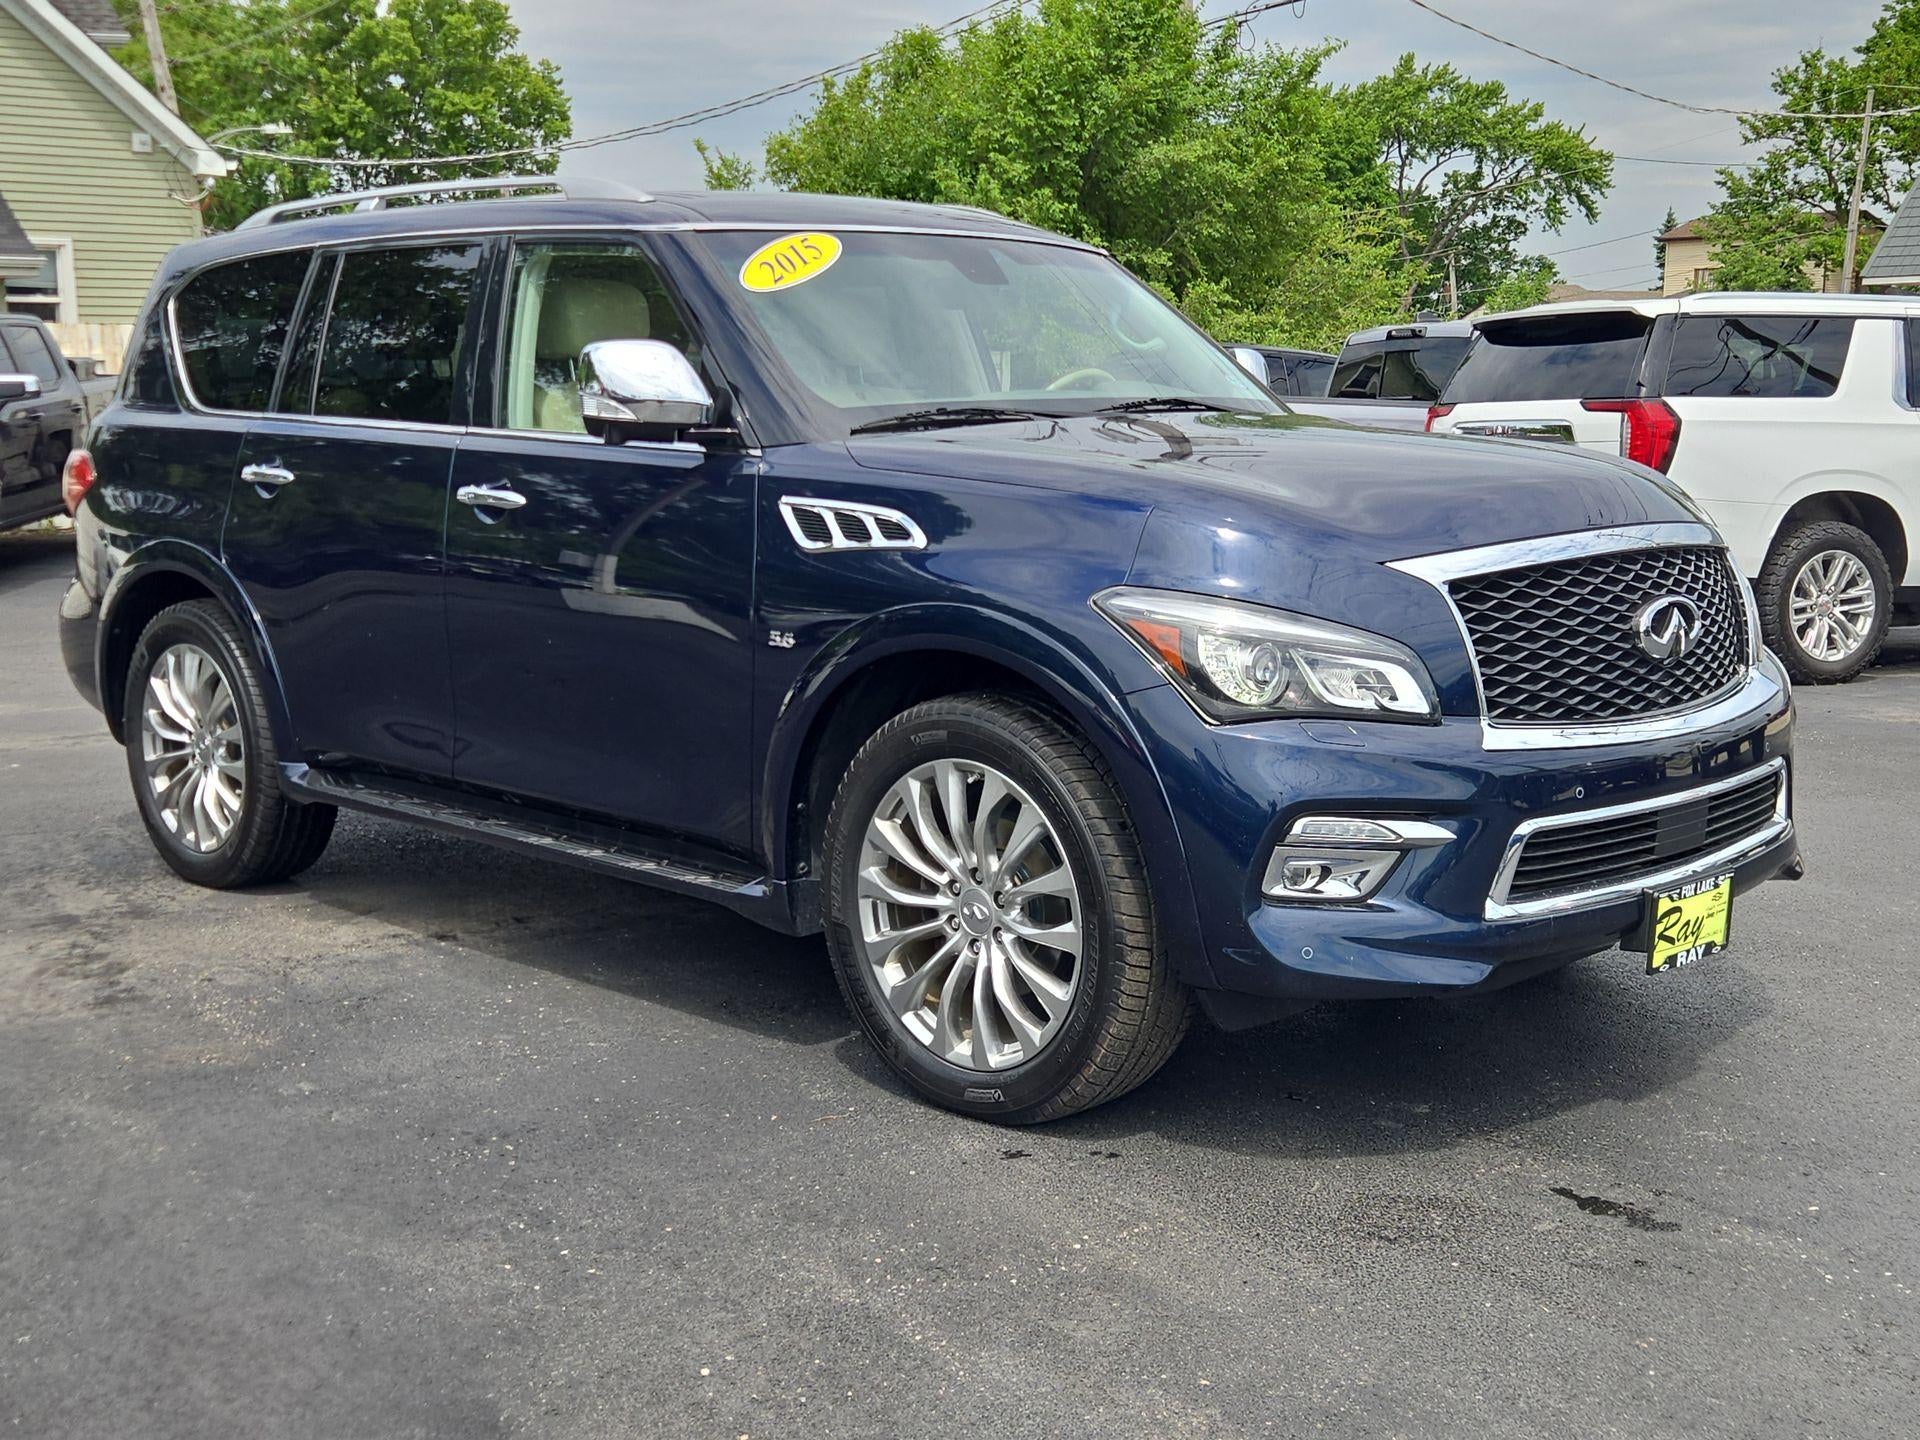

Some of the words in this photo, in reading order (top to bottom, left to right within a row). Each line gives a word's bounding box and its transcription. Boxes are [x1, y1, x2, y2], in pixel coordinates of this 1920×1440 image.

[759, 237, 823, 284] 2015
[1681, 883, 1696, 899] FOX
[1697, 877, 1715, 894] LAKE
[1656, 906, 1704, 947] Ray
[1676, 944, 1705, 968] RAY
